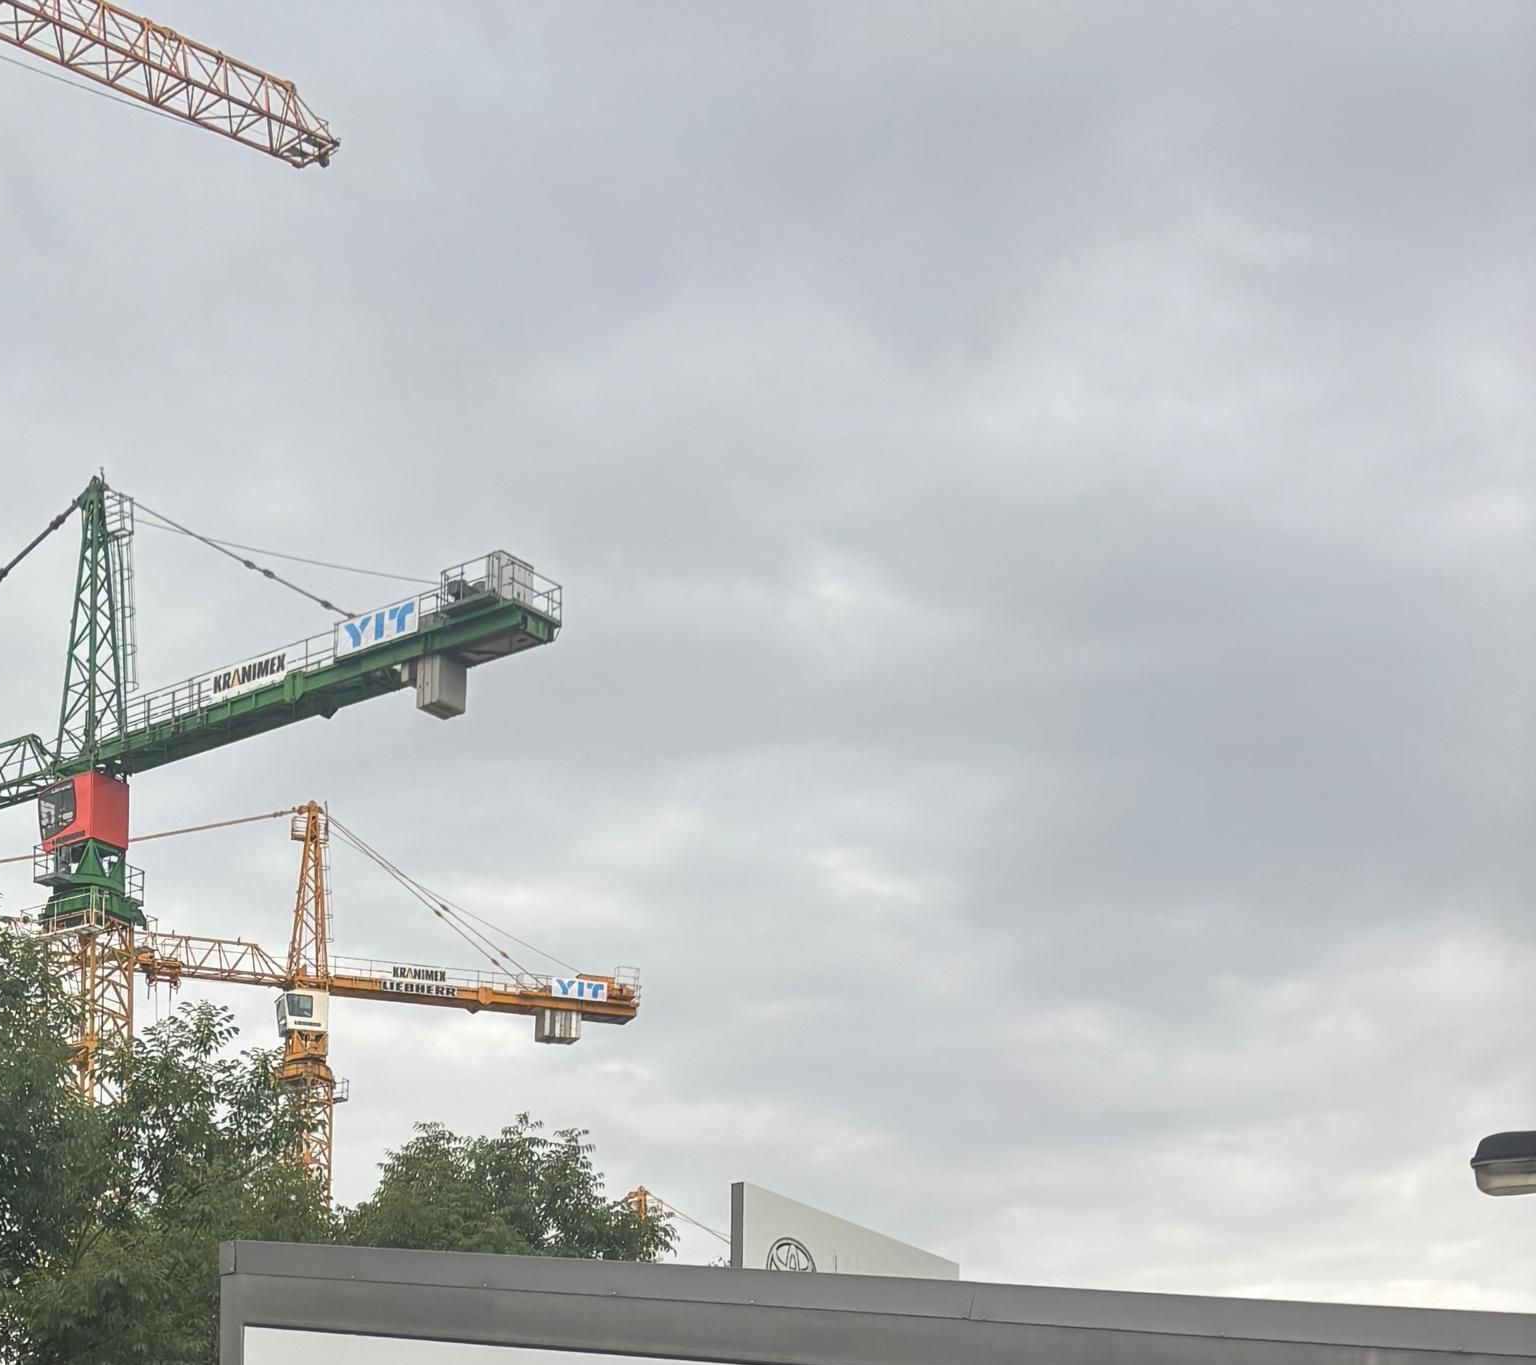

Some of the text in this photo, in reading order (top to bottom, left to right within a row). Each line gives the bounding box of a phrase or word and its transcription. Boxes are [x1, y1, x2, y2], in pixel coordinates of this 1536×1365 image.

[343, 601, 415, 649] YIT
[213, 653, 287, 695] KRANIMEX
[392, 966, 447, 982] KRANIMEX
[382, 981, 456, 997] LIEBHERR
[555, 978, 604, 999] YIT
